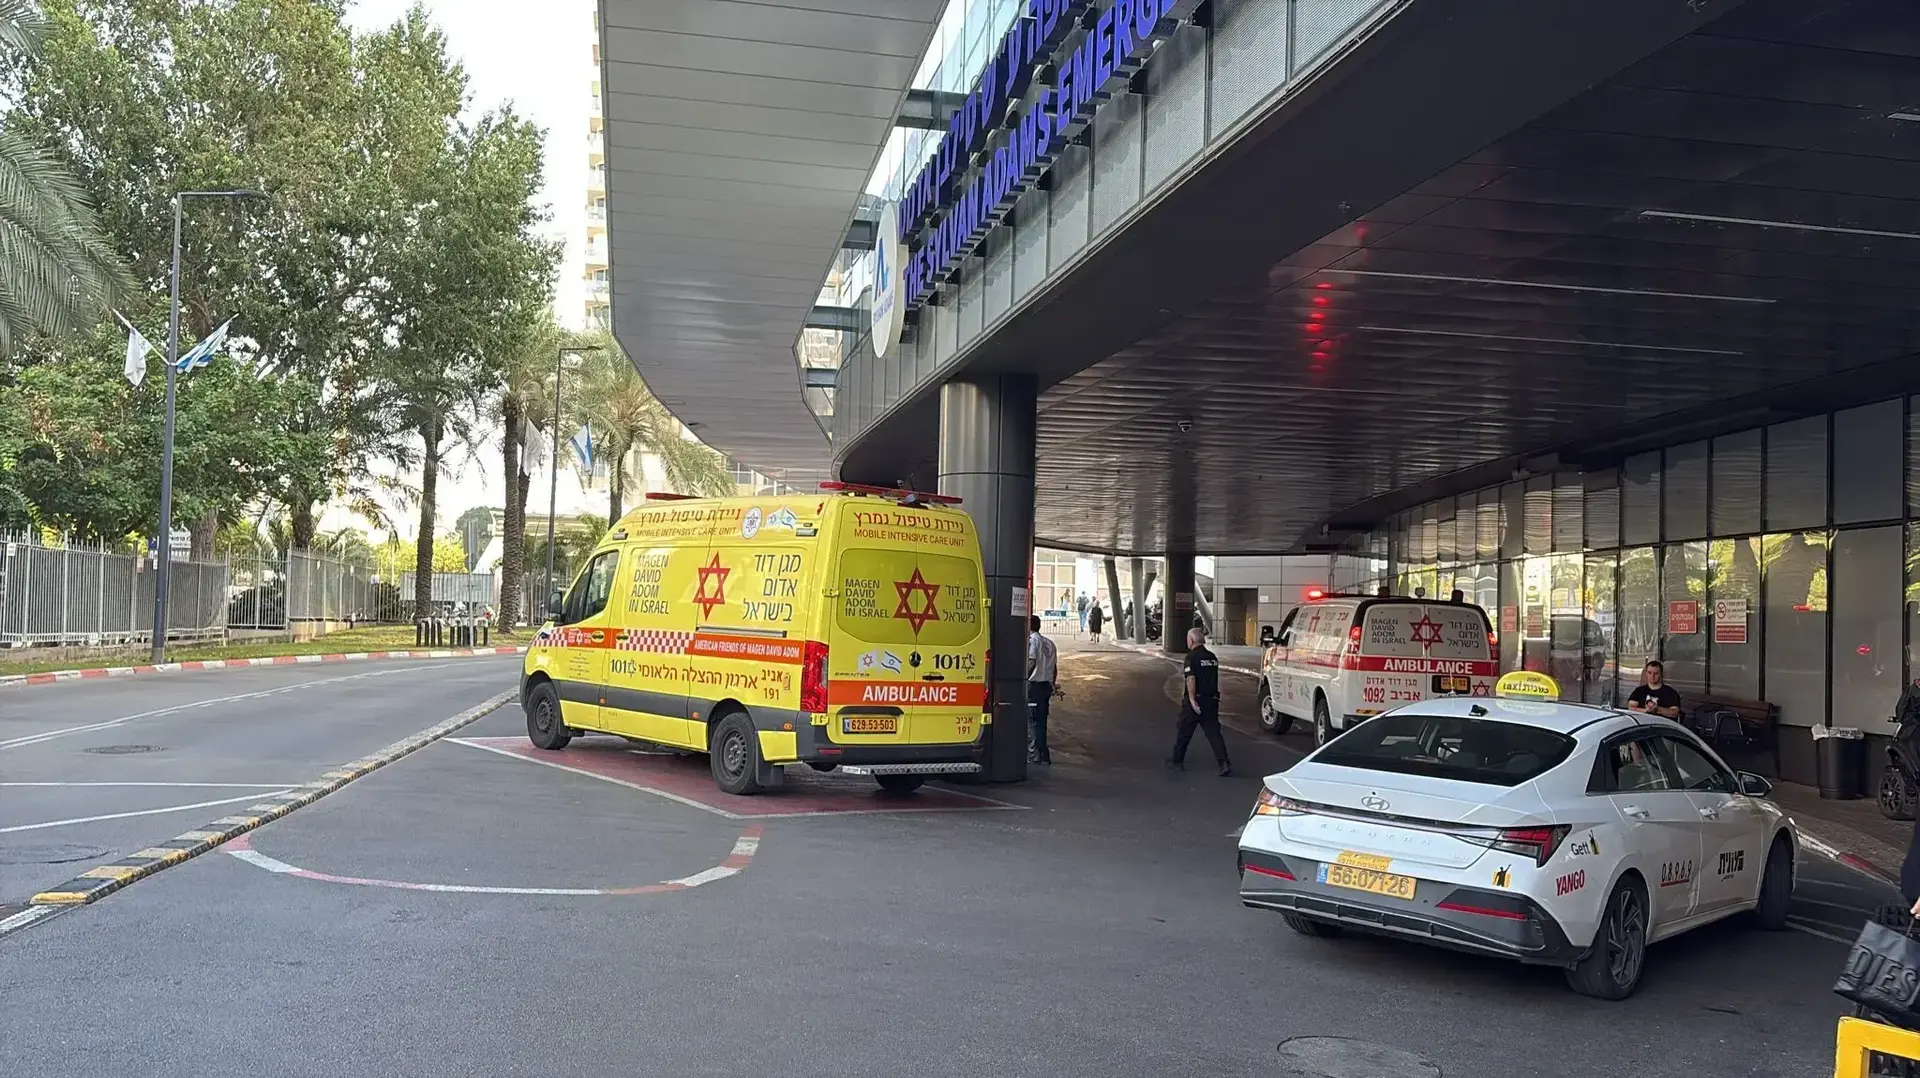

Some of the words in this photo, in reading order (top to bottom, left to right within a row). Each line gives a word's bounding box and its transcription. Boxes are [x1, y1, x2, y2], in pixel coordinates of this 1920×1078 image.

[903, 246, 926, 311] THE
[926, 175, 979, 285] SYLVAN
[982, 88, 1050, 223] ADAMS
[641, 512, 665, 527] נמרץ
[670, 509, 704, 522] טיפול
[706, 508, 741, 521] ניידת
[853, 512, 889, 527] נמרץ
[893, 511, 931, 528] טיפול
[636, 529, 660, 537] MOBILE
[660, 528, 696, 536] INTENSIVE
[698, 527, 718, 536] CARE
[719, 527, 736, 535] UNIT
[934, 519, 964, 533] ניידת
[854, 529, 886, 539] MOBILE
[888, 531, 928, 543] INTENSIVE
[929, 535, 948, 545] CARE
[949, 537, 965, 547] UNIT
[637, 554, 669, 568] MAGEN
[755, 554, 775, 572] דוד
[778, 554, 802, 576] מגן
[634, 570, 661, 583] DAVID
[763, 578, 798, 597] אדום
[845, 579, 880, 589] MAGEN
[946, 585, 960, 596] דוד
[631, 585, 660, 598] ADOM
[845, 588, 875, 598] DAVID
[963, 587, 976, 598] מגן
[628, 600, 638, 613] IN
[640, 601, 669, 615] ISRAEL
[845, 598, 876, 608] ADOM
[955, 599, 976, 610] אדום
[742, 598, 793, 622] בישראל
[845, 608, 856, 617] IN
[859, 608, 890, 618] ISRAEL
[943, 609, 976, 623] בישראל
[1371, 618, 1399, 626] MAGEN
[1448, 621, 1463, 630] דוד
[1465, 623, 1479, 632] מגן
[1382, 637, 1407, 645] ISRAEL
[1458, 631, 1480, 639] אדום
[695, 640, 718, 651] AMERICAN
[718, 642, 739, 653] FRIENDS
[739, 643, 747, 653] OF
[747, 643, 766, 655] MAGEN
[766, 645, 782, 657] DAVID
[782, 646, 800, 658] ADOM
[1447, 637, 1479, 649] בישראל
[611, 659, 627, 674] 101
[932, 653, 960, 670] 101
[1383, 659, 1473, 674] AMBULANCE
[638, 664, 678, 680] הלאומי
[682, 667, 722, 685] ההצלה
[761, 669, 783, 683] אביב
[725, 673, 758, 690] ארגון
[1366, 676, 1385, 685] אדום
[1388, 677, 1401, 686] דוד
[1405, 679, 1418, 687] מגן
[1503, 680, 1522, 690] taxi
[763, 688, 779, 700] 191
[862, 685, 958, 702] AMBULANCE
[1363, 687, 1385, 703] 1092
[1390, 691, 1421, 701] אביב
[955, 716, 973, 725] אביב
[957, 726, 971, 734] 191
[1571, 843, 1591, 856] Gett
[1556, 869, 1585, 897] YANGO
